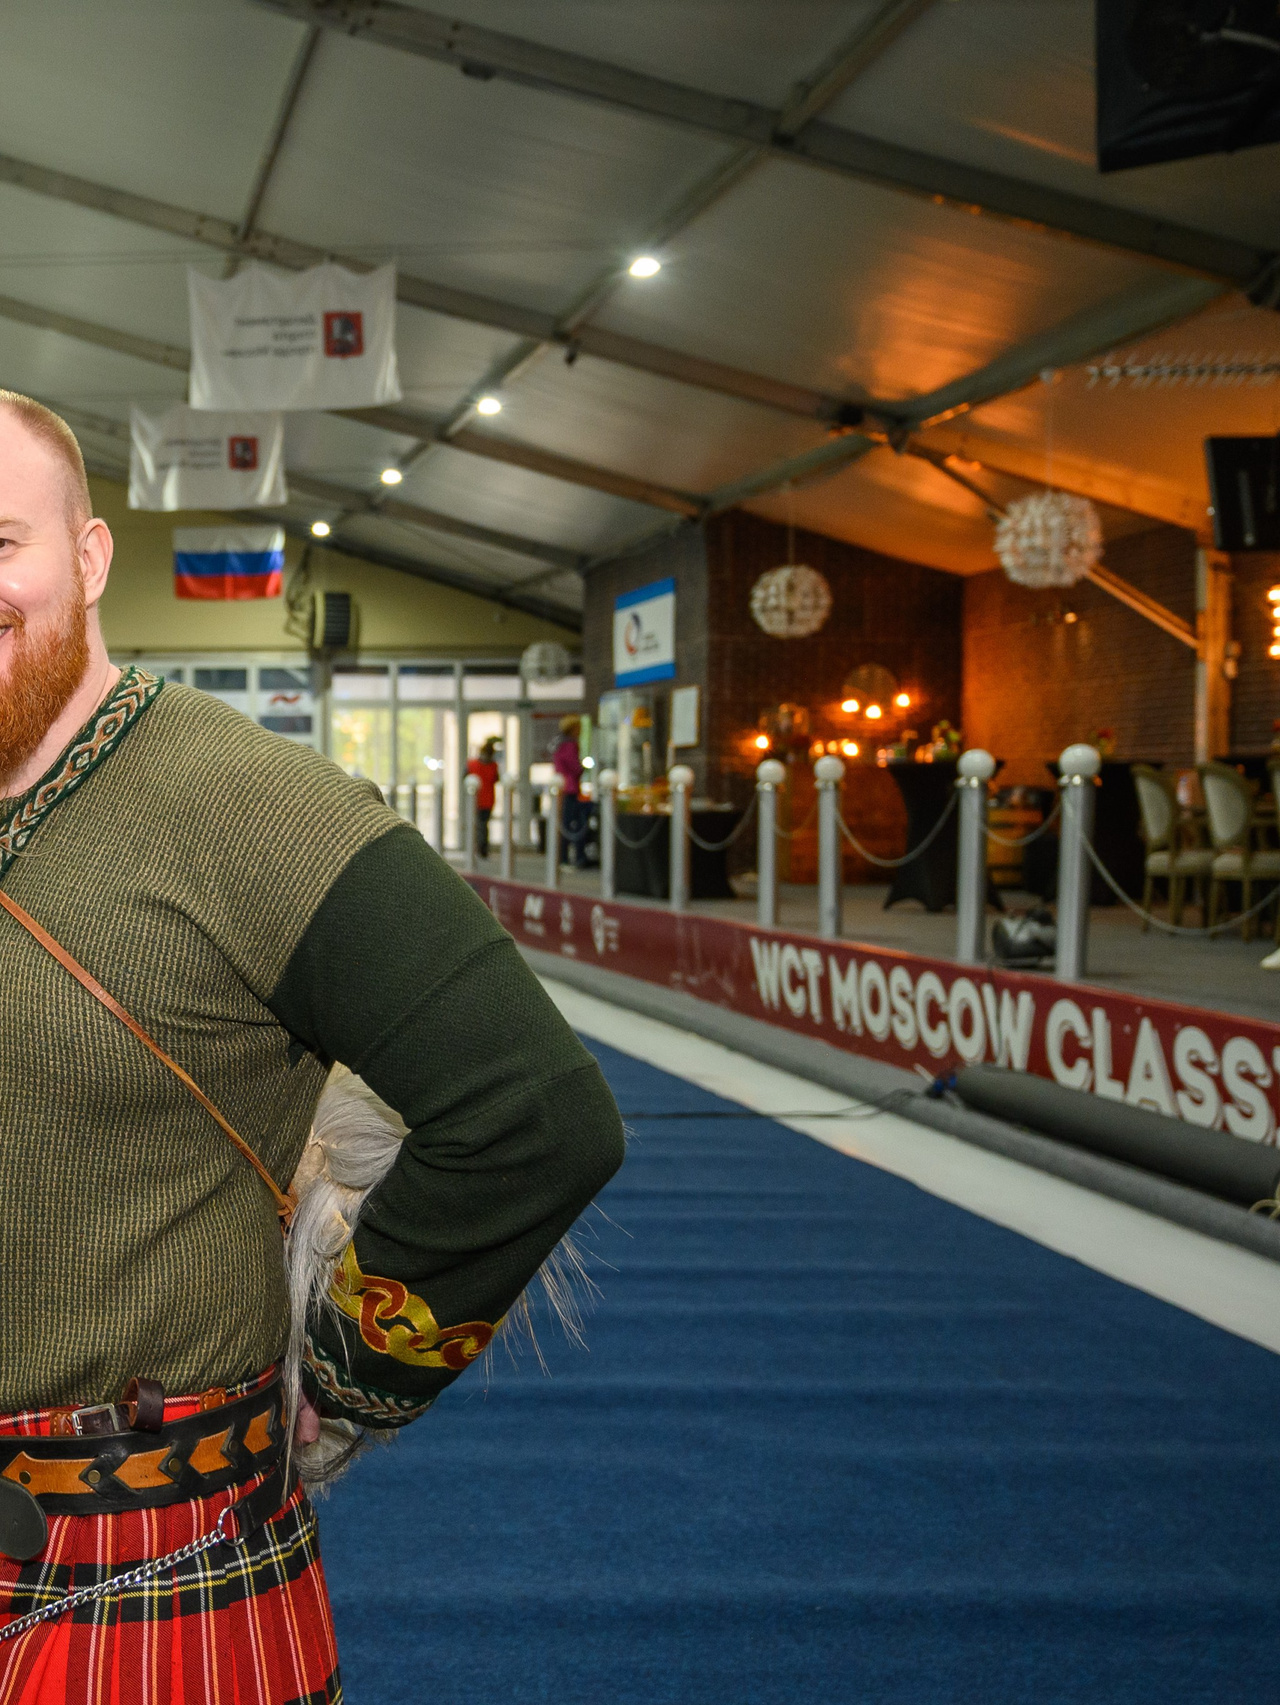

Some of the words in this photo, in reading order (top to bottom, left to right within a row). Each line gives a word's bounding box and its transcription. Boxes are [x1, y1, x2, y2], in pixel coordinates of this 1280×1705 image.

[750, 937, 825, 1023] WCT
[829, 955, 1035, 1071] MOSCOW
[1046, 999, 1280, 1147] CLASS
